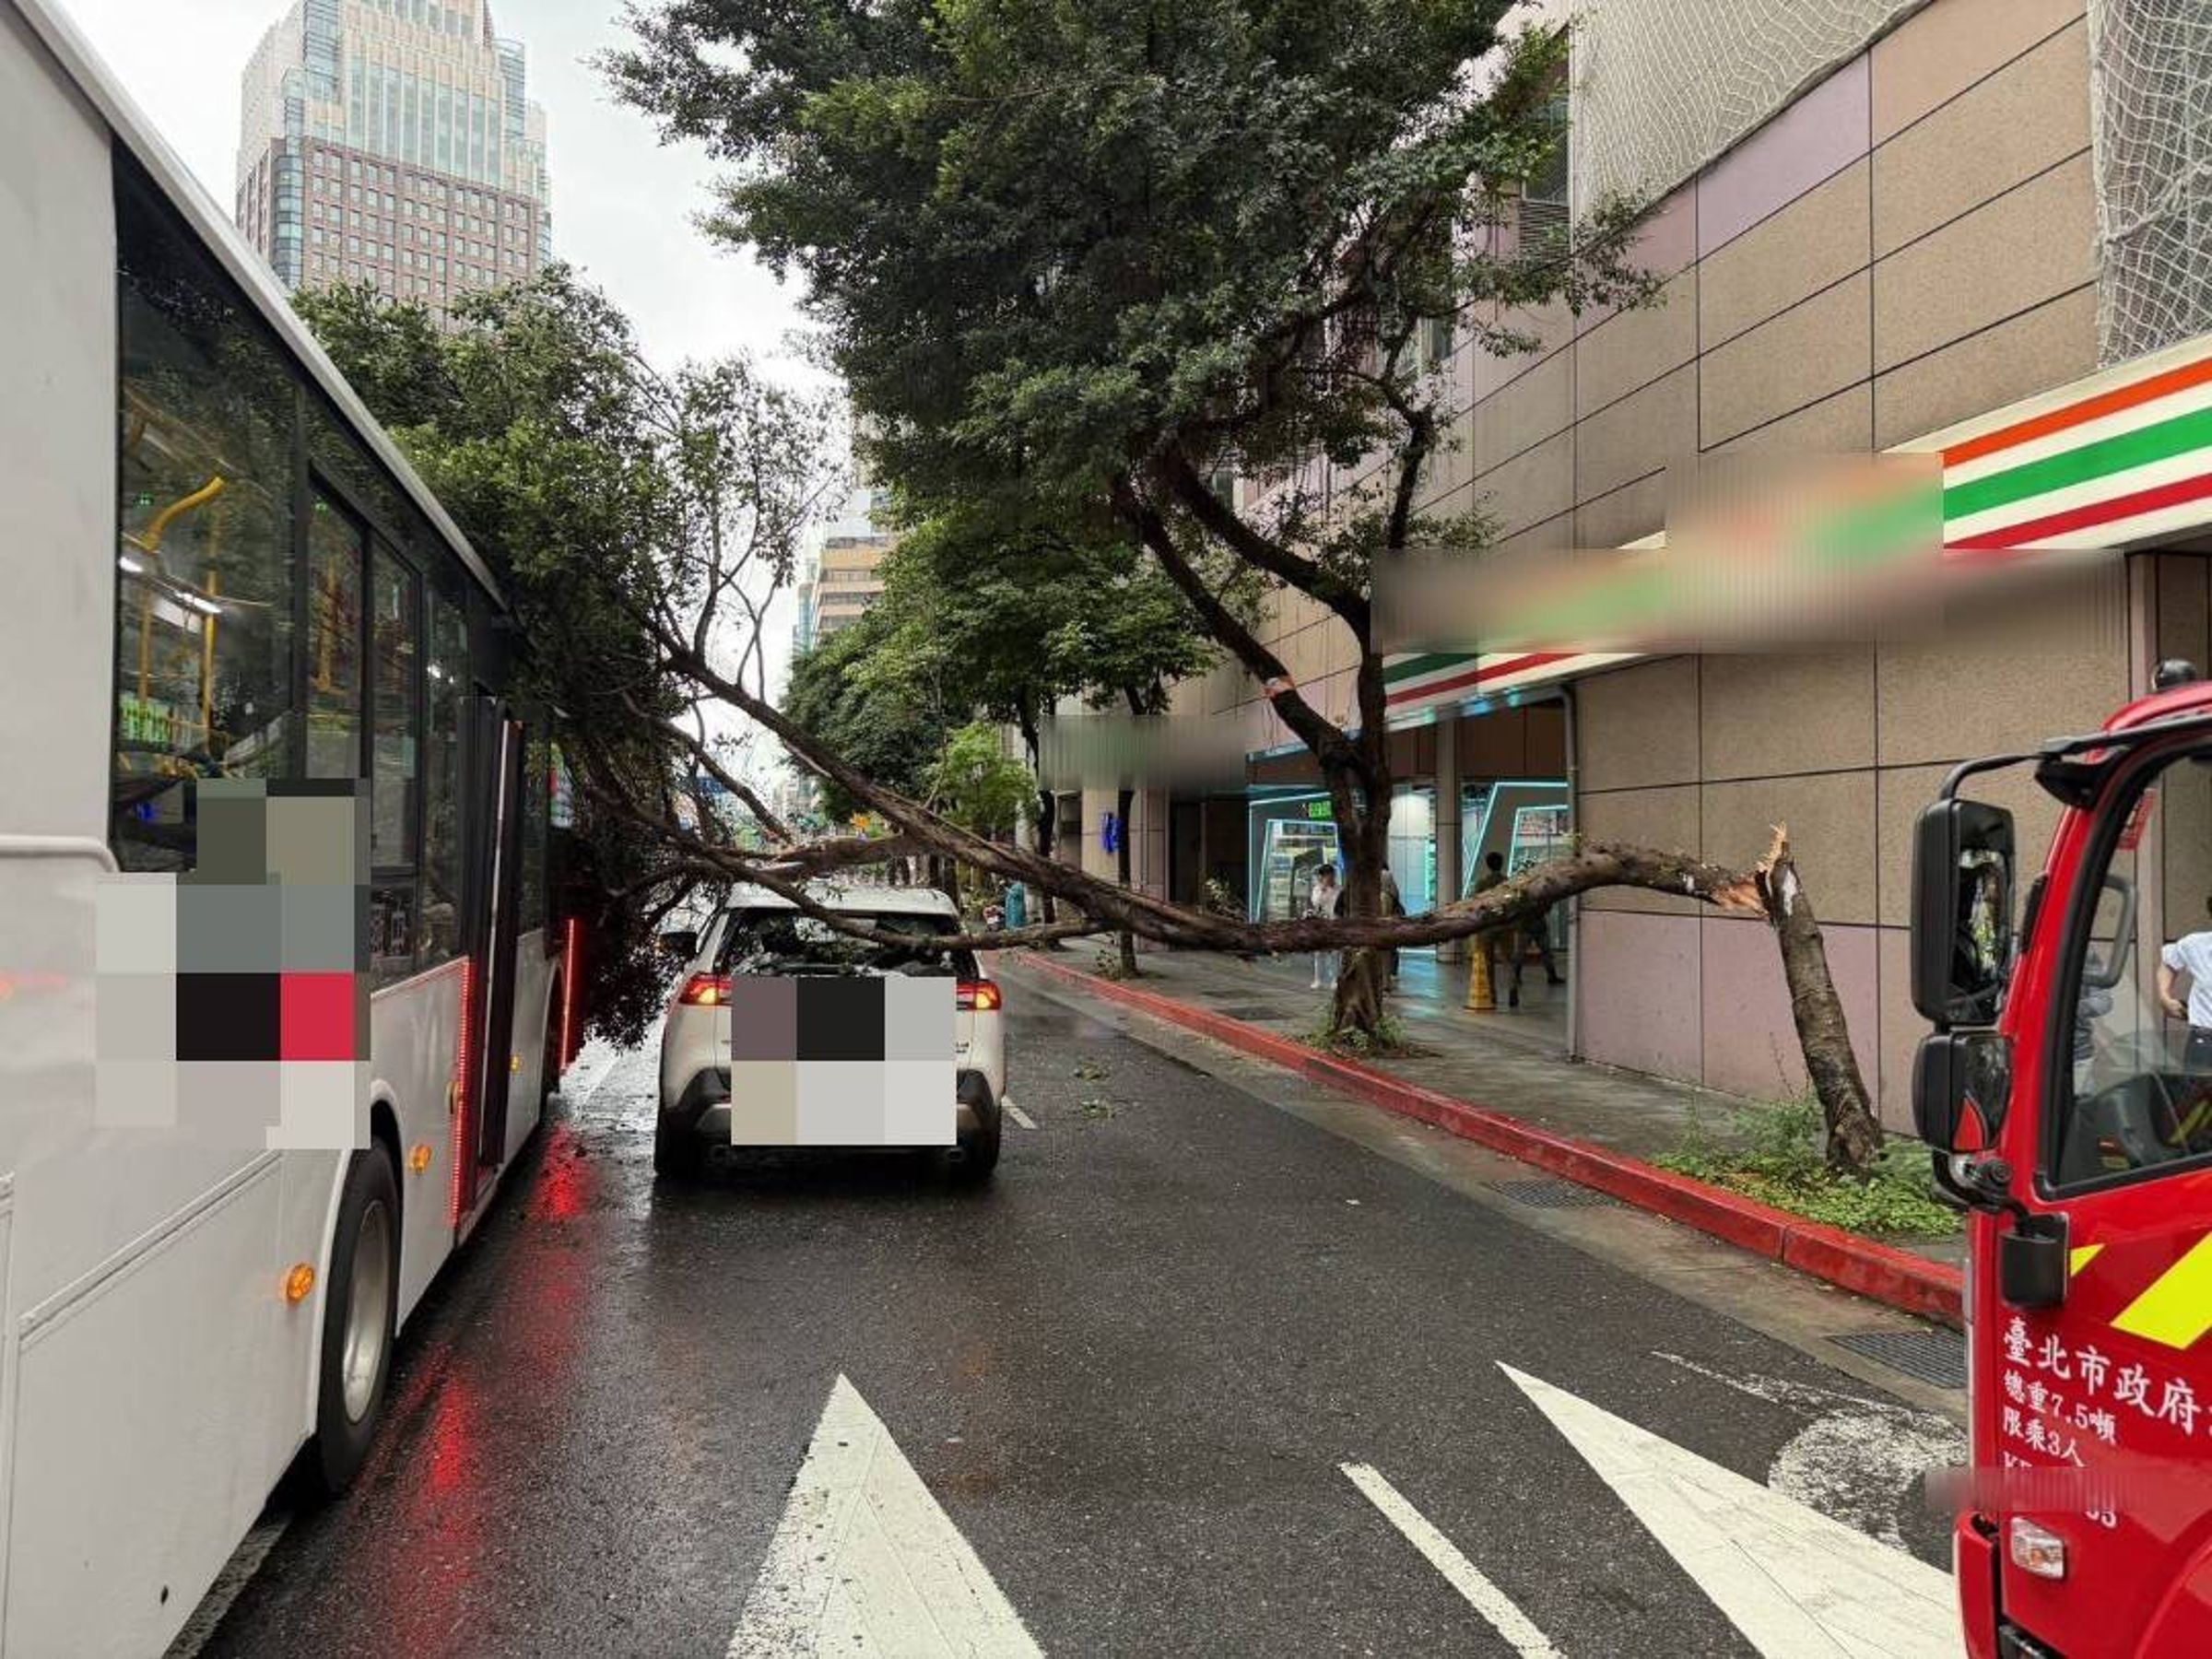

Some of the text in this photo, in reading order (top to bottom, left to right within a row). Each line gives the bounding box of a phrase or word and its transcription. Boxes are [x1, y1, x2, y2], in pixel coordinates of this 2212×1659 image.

[2004, 1316, 2212, 1436] 臺北市政府
[2004, 1405, 2086, 1467] 限乘3人
